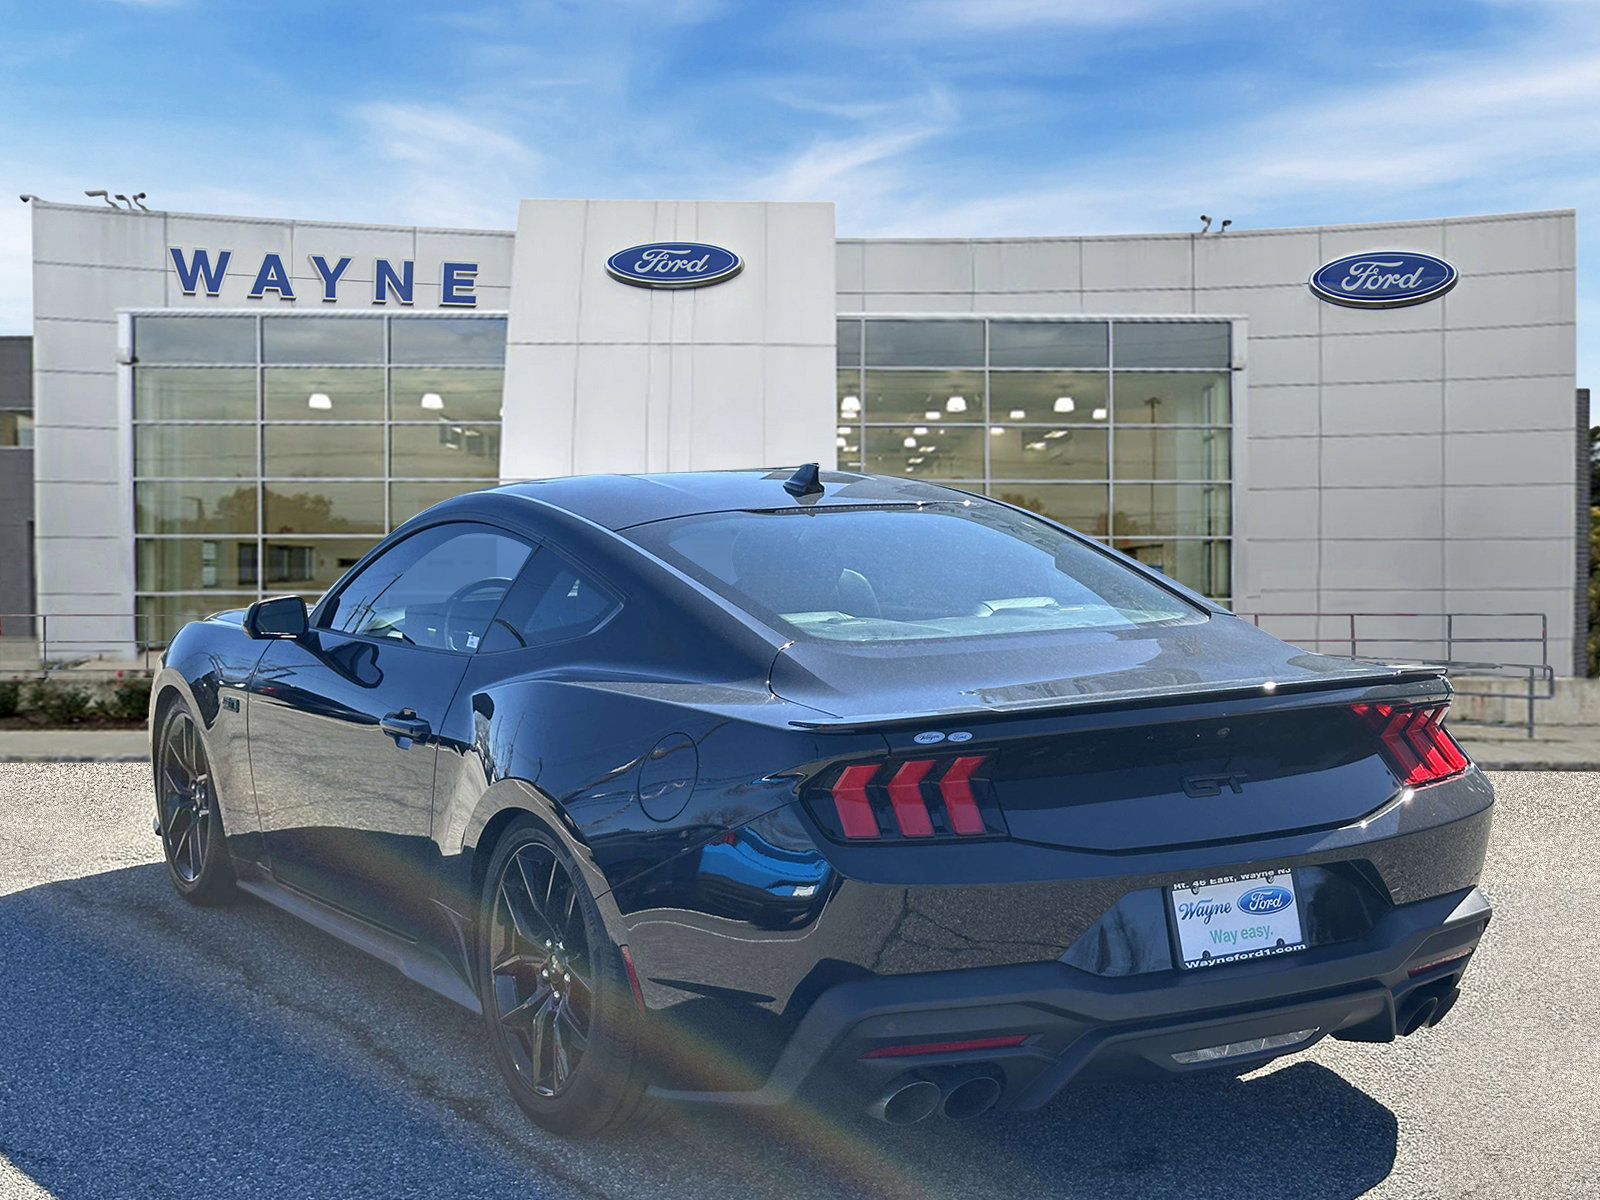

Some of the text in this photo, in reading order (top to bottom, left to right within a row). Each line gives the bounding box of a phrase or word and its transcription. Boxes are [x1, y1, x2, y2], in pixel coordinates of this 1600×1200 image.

[634, 249, 710, 273] Ford
[169, 247, 478, 306] WAYNE
[1341, 261, 1424, 291] Ford
[1181, 774, 1248, 798] GT
[1178, 890, 1283, 924] Wayne Ford
[1209, 925, 1274, 945] Way easy.
[1185, 943, 1306, 969] Wayneford1.com
